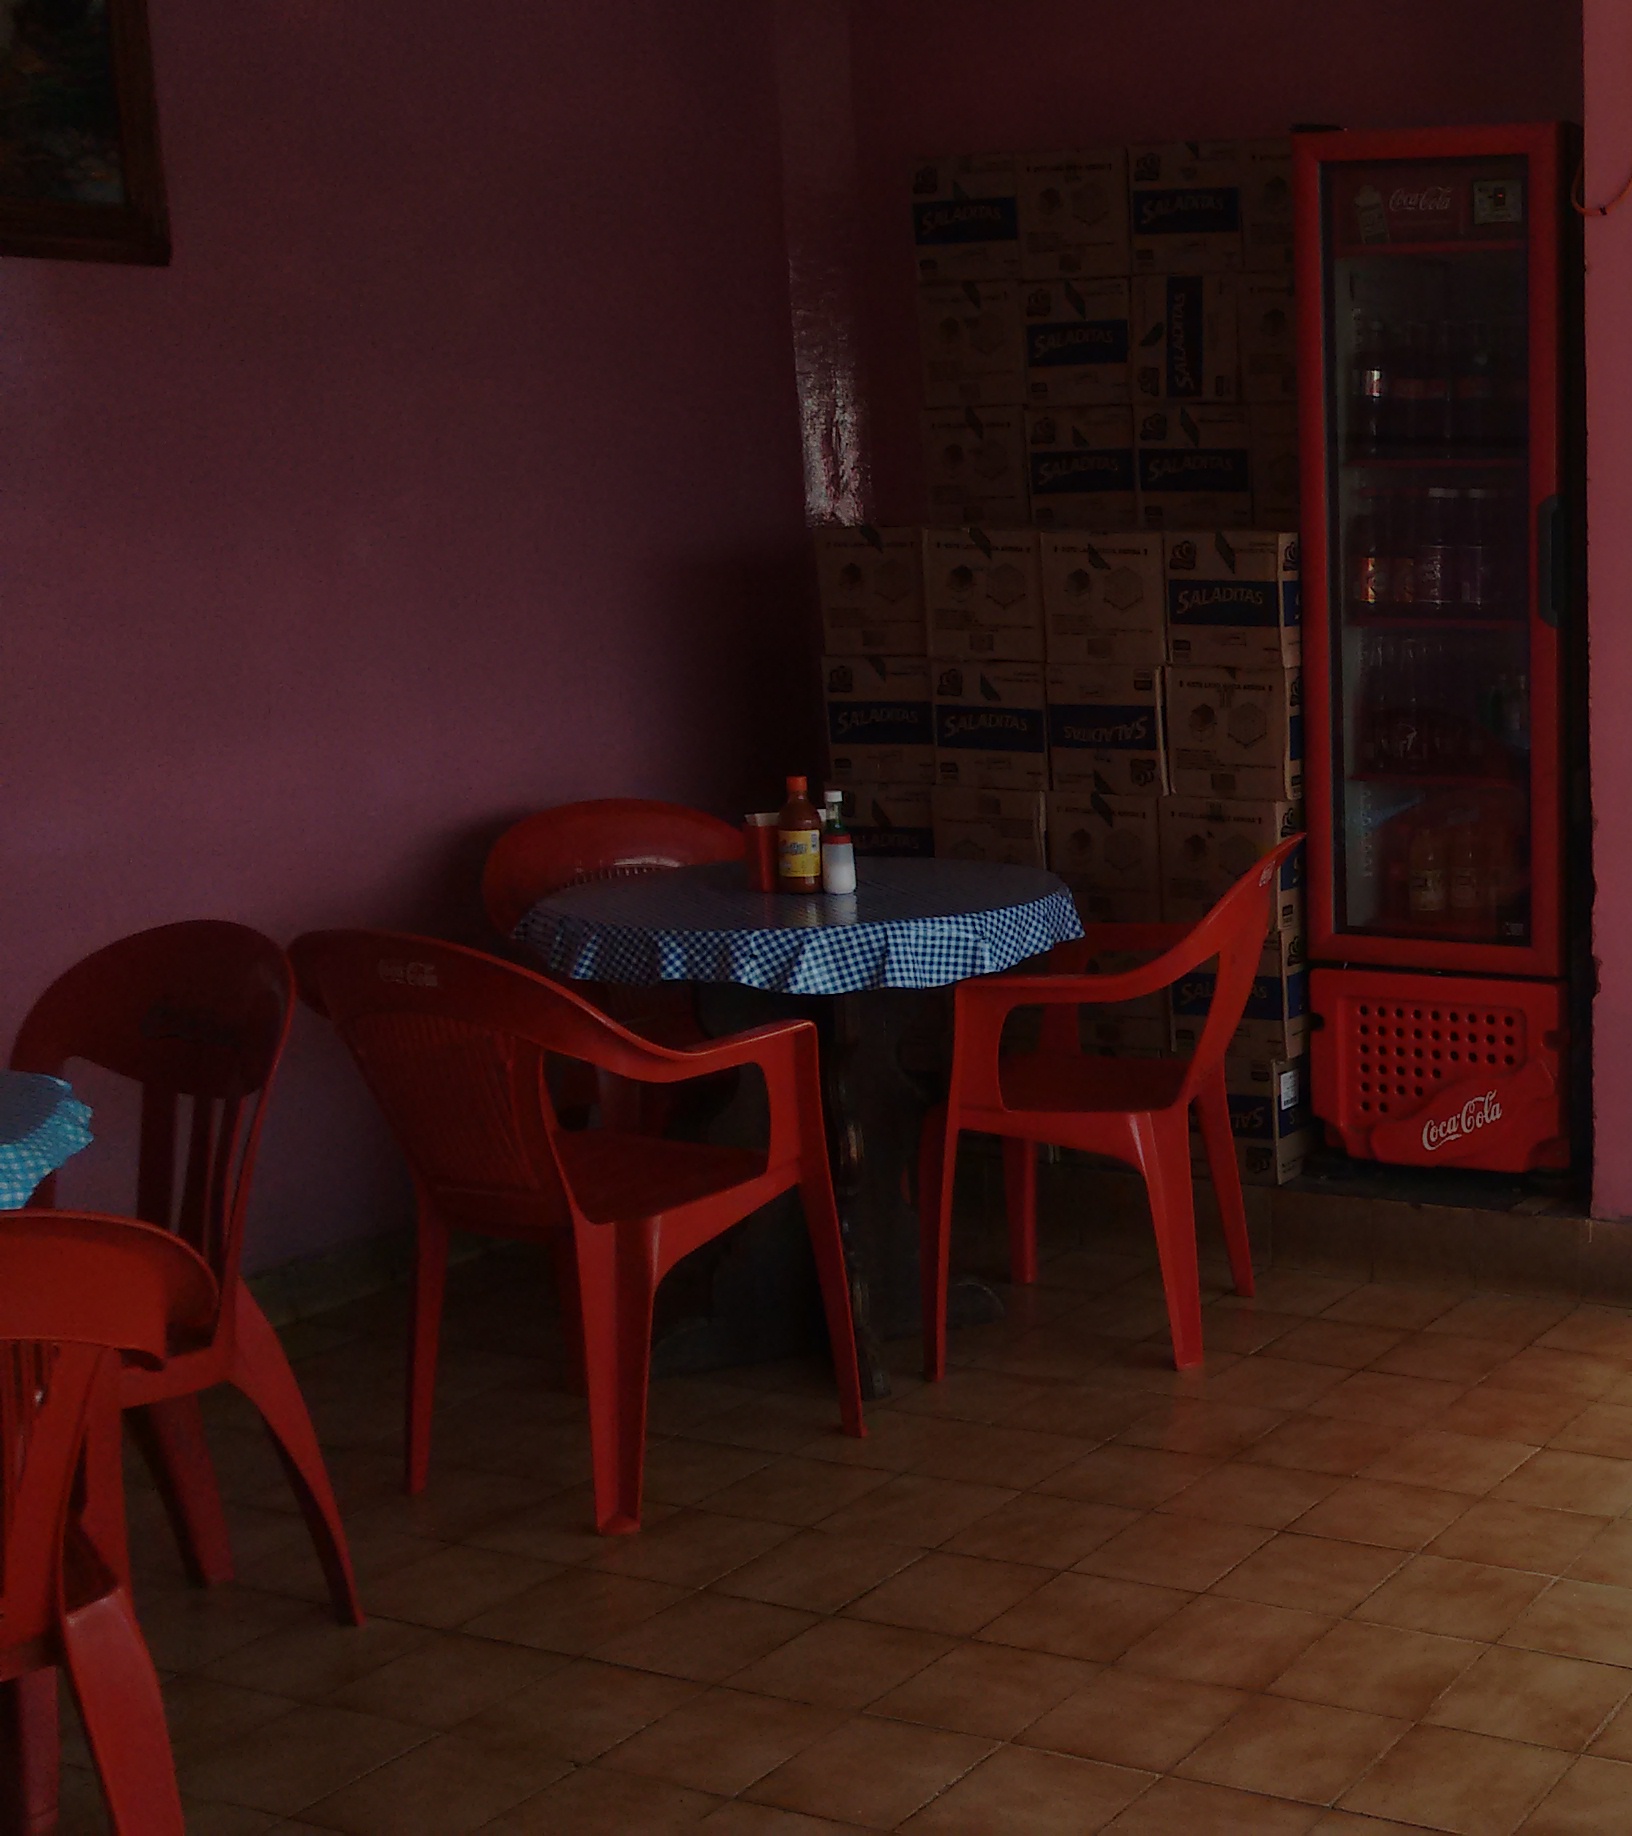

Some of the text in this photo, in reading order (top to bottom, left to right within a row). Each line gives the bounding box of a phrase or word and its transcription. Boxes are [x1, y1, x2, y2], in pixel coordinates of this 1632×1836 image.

[1176, 586, 1265, 615] SALADITAS
[836, 707, 919, 736] SALADITAS
[943, 712, 1029, 738] SALADITAS
[1422, 1089, 1502, 1151] Coca-Cola
